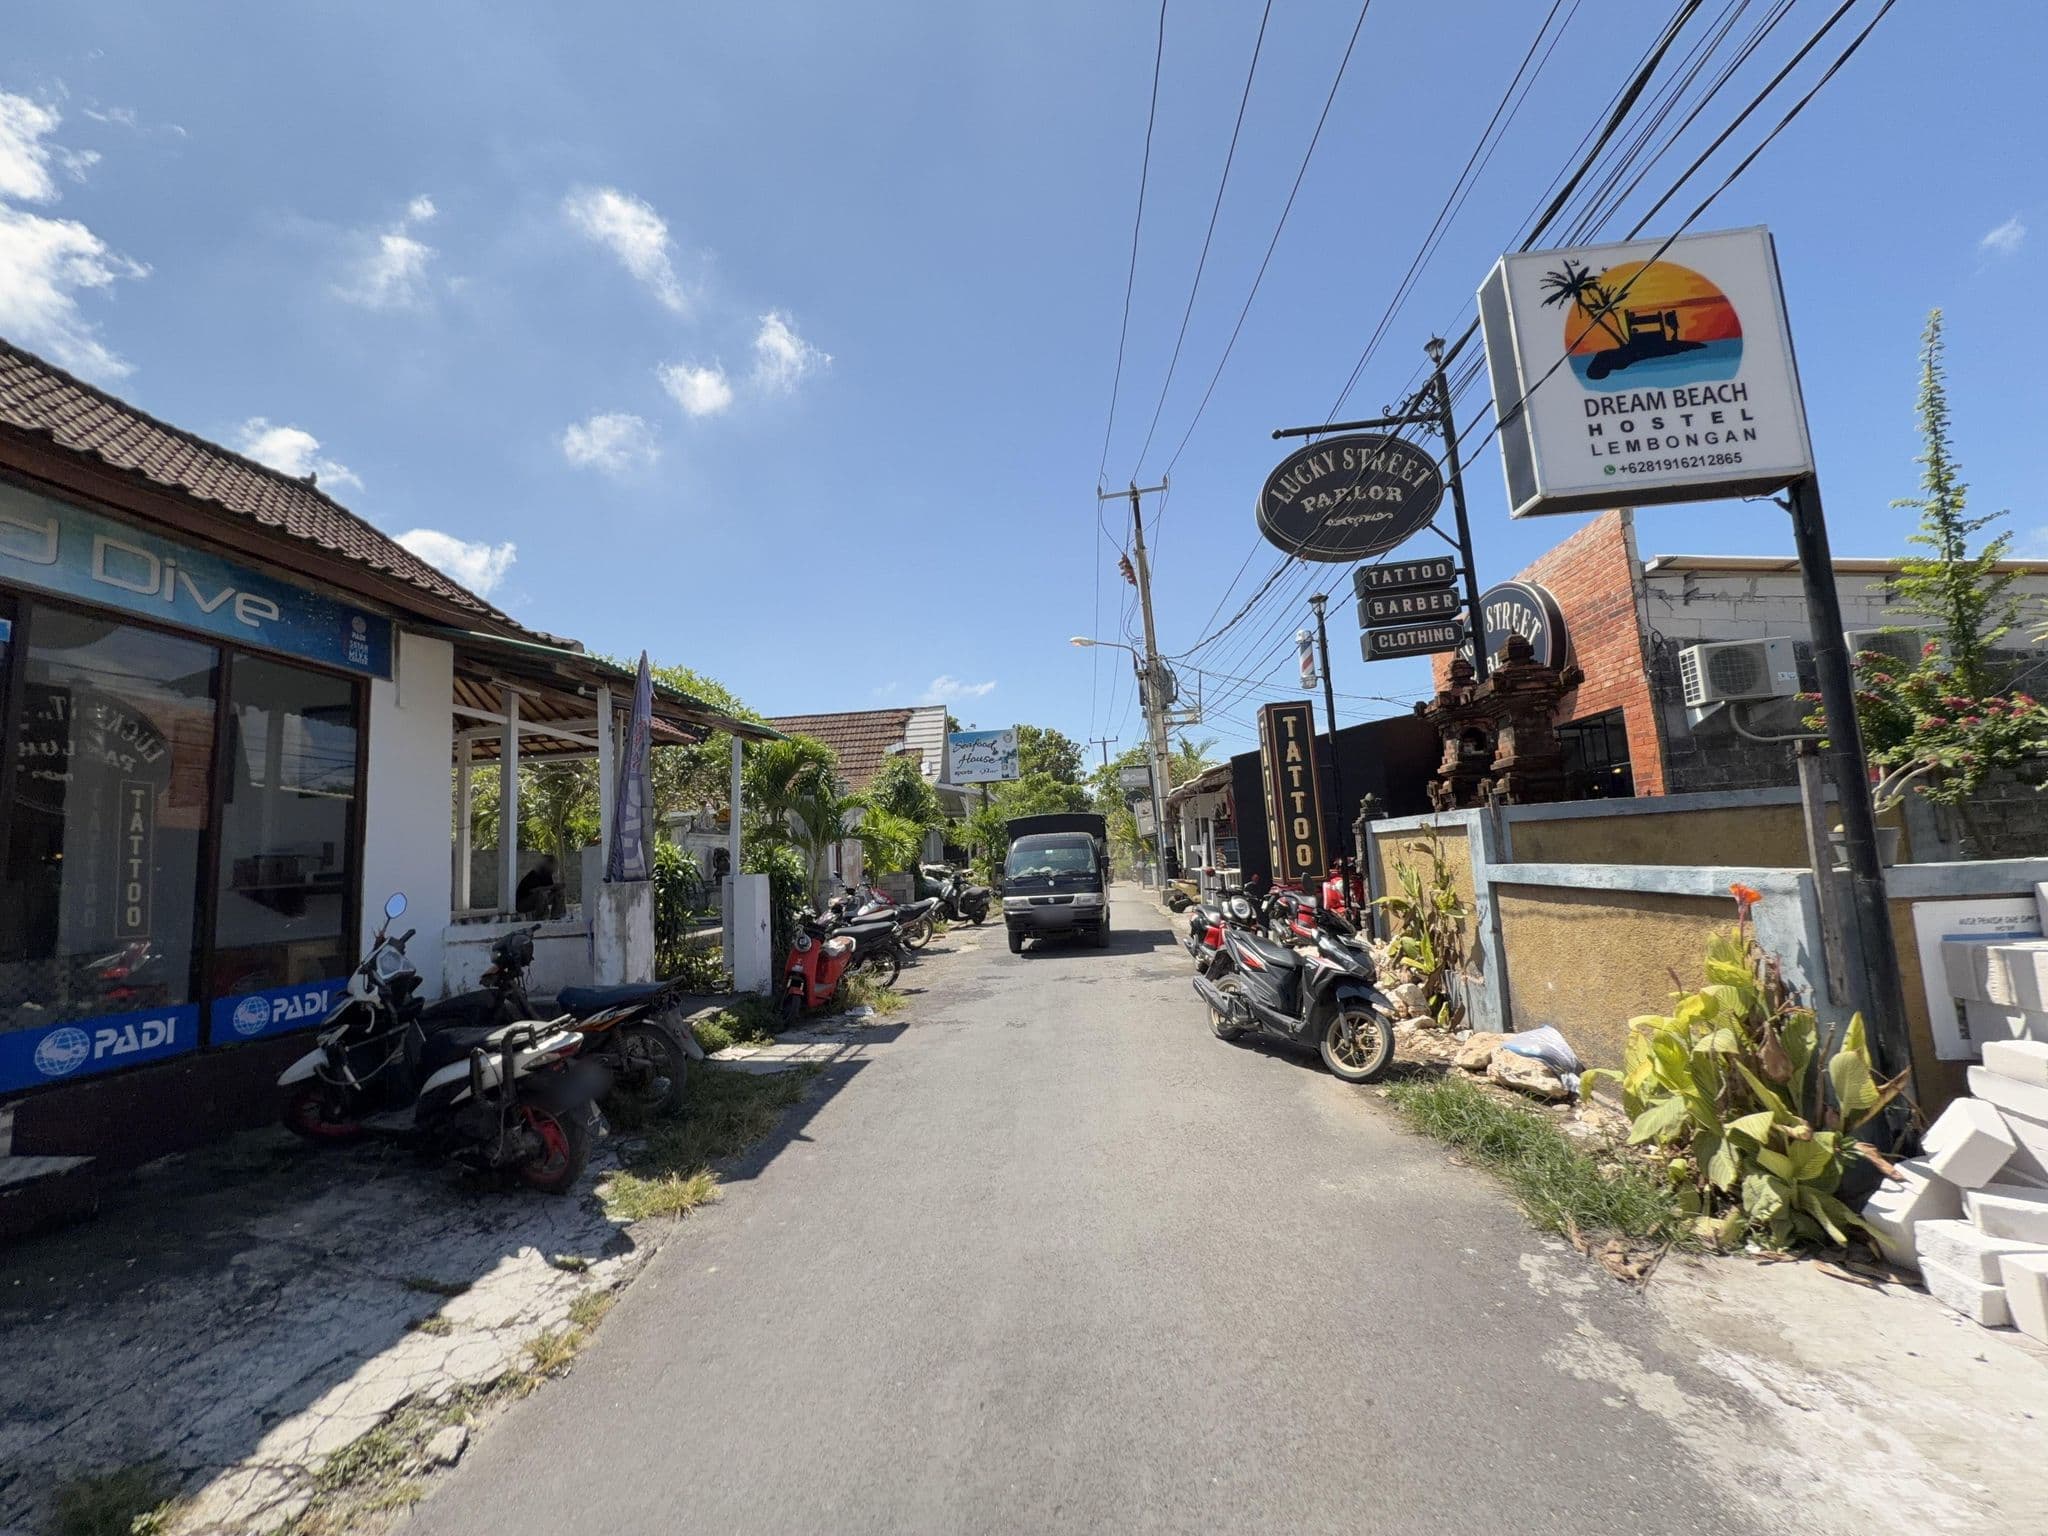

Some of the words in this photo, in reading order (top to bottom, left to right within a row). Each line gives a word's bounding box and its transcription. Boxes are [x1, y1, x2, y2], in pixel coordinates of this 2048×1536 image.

[1584, 391, 1667, 418] DREAM
[1672, 382, 1749, 409] BEACH
[1588, 408, 1754, 437] HOSTEL
[1591, 427, 1758, 457] LEMBONGAN
[1270, 449, 1336, 504] LUCKY
[1342, 447, 1435, 488] STREET
[1619, 452, 1743, 474] +6281916212865
[1300, 485, 1403, 514] PARLOR
[91, 533, 281, 628] Dive
[1369, 562, 1447, 586] TATTOO
[1374, 594, 1454, 616] BARBER
[1378, 626, 1456, 648] CLOTHING
[1486, 601, 1542, 646] STREET
[1282, 715, 1313, 867] TATTOO
[272, 990, 330, 1024] PADI
[94, 1017, 178, 1059] PADI
